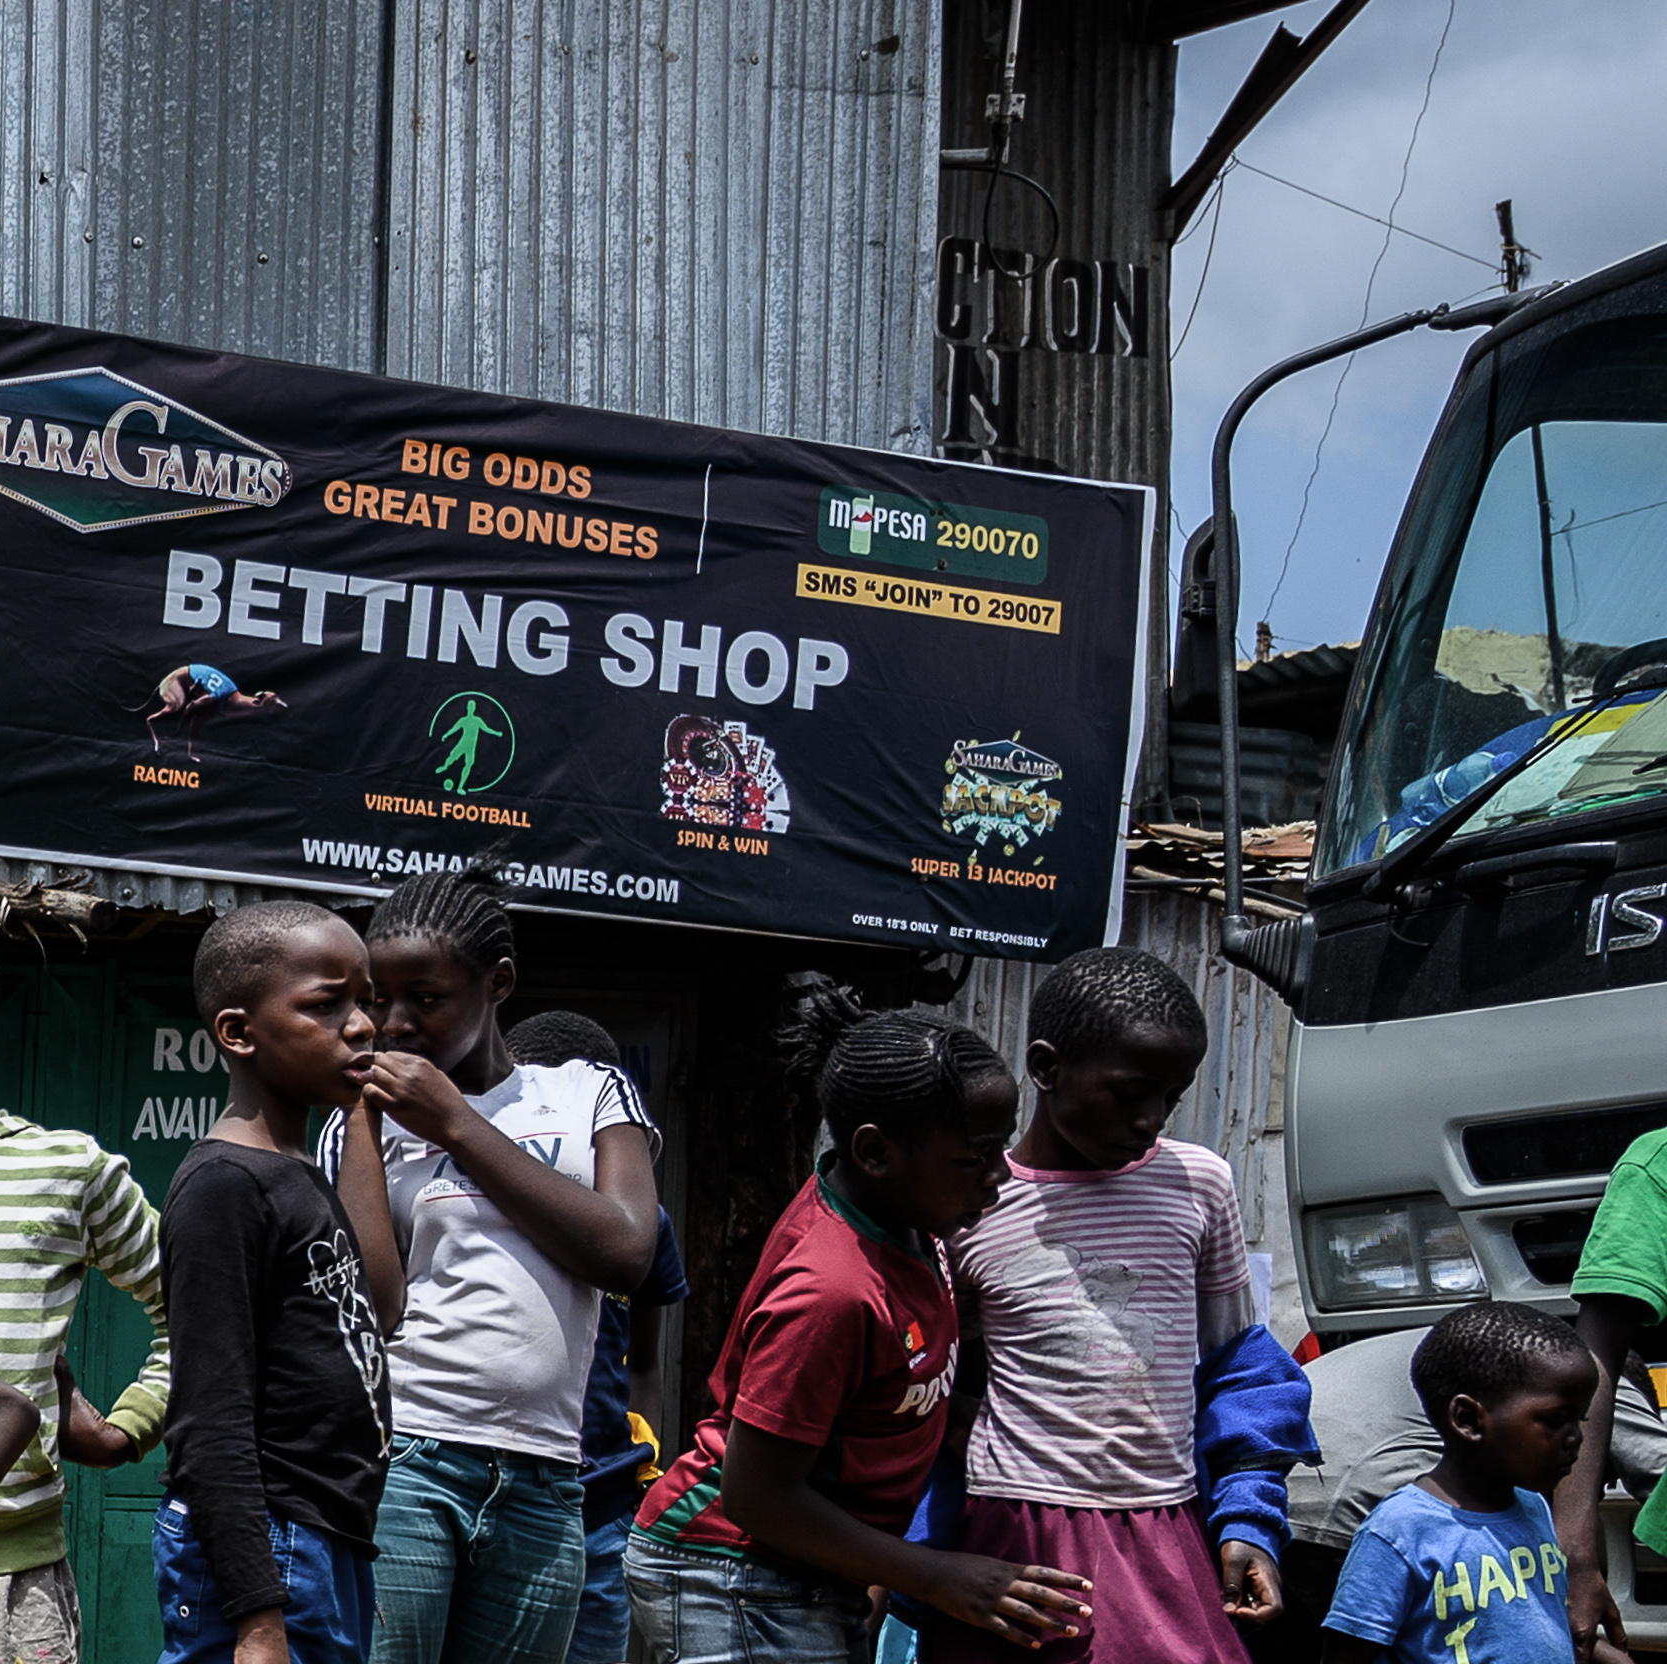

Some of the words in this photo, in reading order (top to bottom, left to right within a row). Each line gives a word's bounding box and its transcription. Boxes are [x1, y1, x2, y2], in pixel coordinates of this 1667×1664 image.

[401, 438, 471, 480] BIG
[483, 452, 593, 499] ODDS
[323, 479, 458, 531] GREAT
[469, 501, 659, 560] BONUSES
[936, 520, 1040, 561] 290070
[804, 571, 858, 598] SMS
[949, 593, 980, 616] TO
[987, 598, 1056, 626] 29007
[163, 548, 571, 677] BETTING
[600, 611, 850, 711] SHOP
[208, 673, 223, 692] 2
[133, 764, 200, 788] RACING
[364, 792, 438, 818] VIRTUAL
[441, 799, 531, 829] FOOTBALL
[940, 783, 1063, 831] JACKPOT
[677, 829, 714, 850] SPIN
[717, 836, 730, 852] &
[734, 836, 769, 857] WIN
[301, 838, 680, 904] WWW.SAHAGAMES.COM
[910, 855, 960, 879] SUPER
[967, 864, 983, 882] 13
[987, 866, 1057, 891] JACKPOT
[852, 913, 883, 928] OVER
[910, 920, 939, 934] ONLY
[949, 925, 973, 940] BET
[974, 929, 1048, 948] RESPONSIBLY
